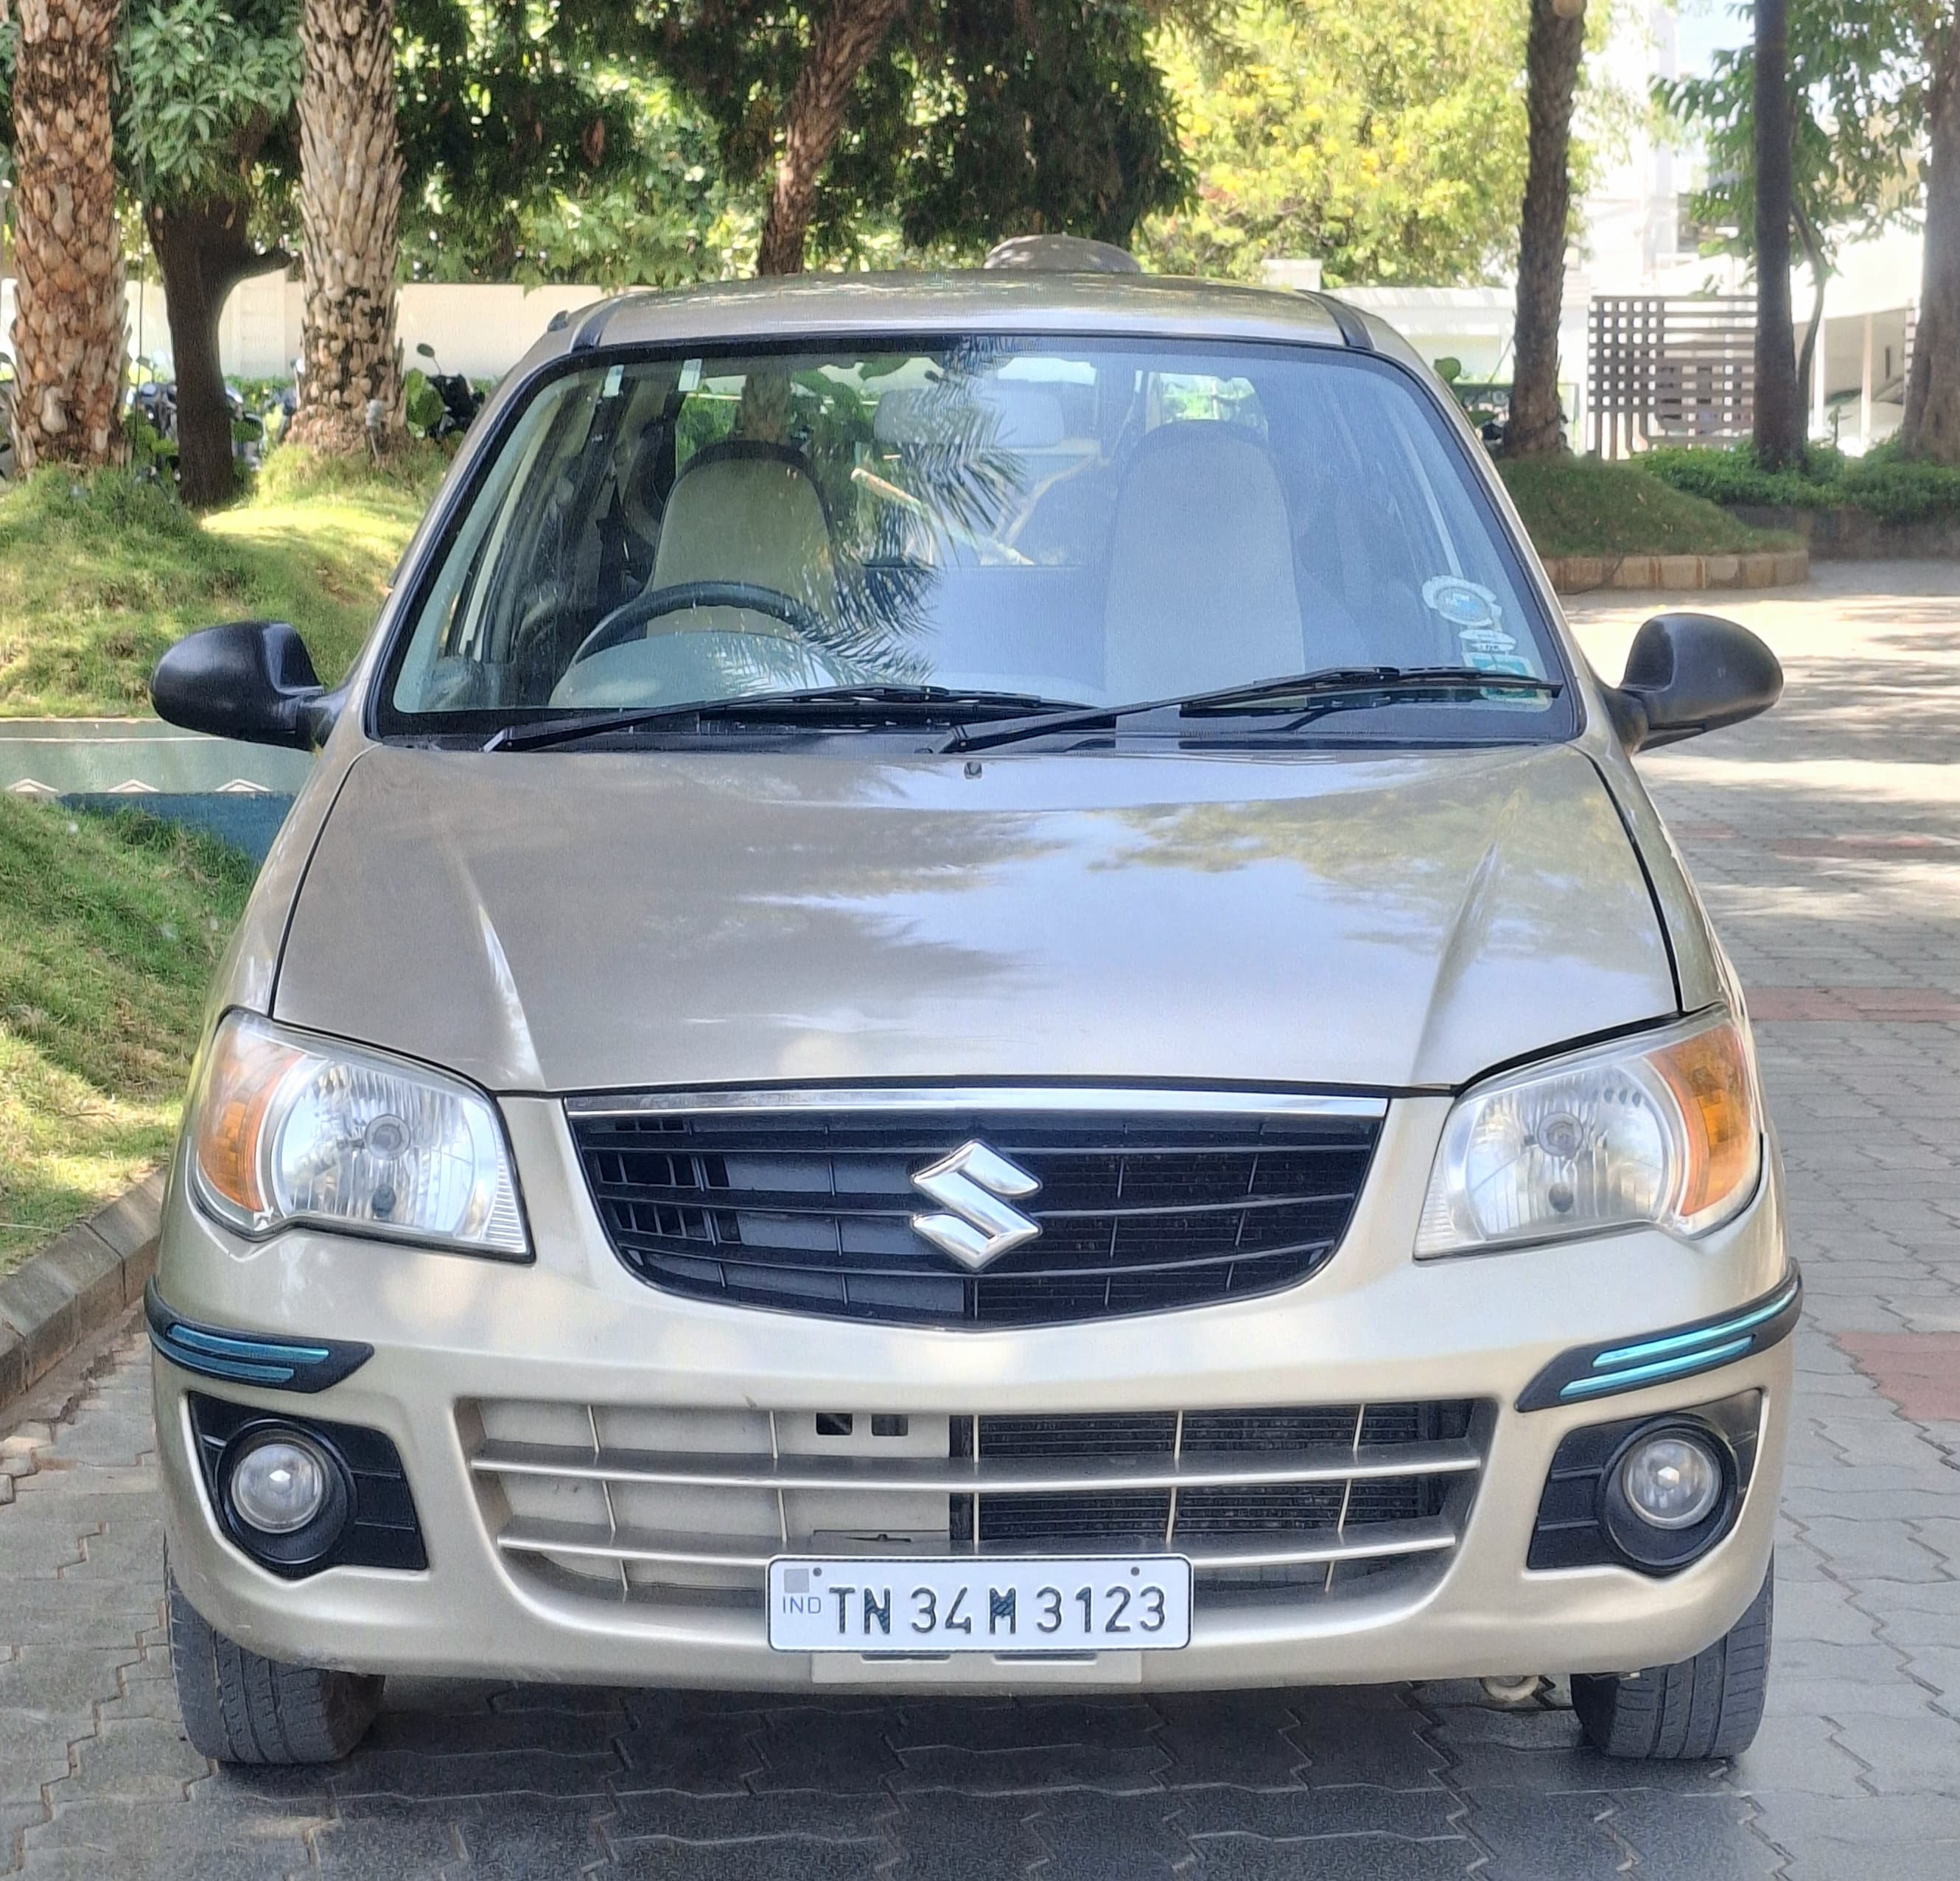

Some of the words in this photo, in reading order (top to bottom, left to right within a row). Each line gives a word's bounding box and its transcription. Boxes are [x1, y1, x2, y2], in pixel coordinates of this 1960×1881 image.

[783, 1596, 822, 1614] IND
[829, 1587, 891, 1634] TN
[911, 1586, 972, 1634] 34
[990, 1587, 1016, 1634] M
[1035, 1586, 1166, 1633] 3123
